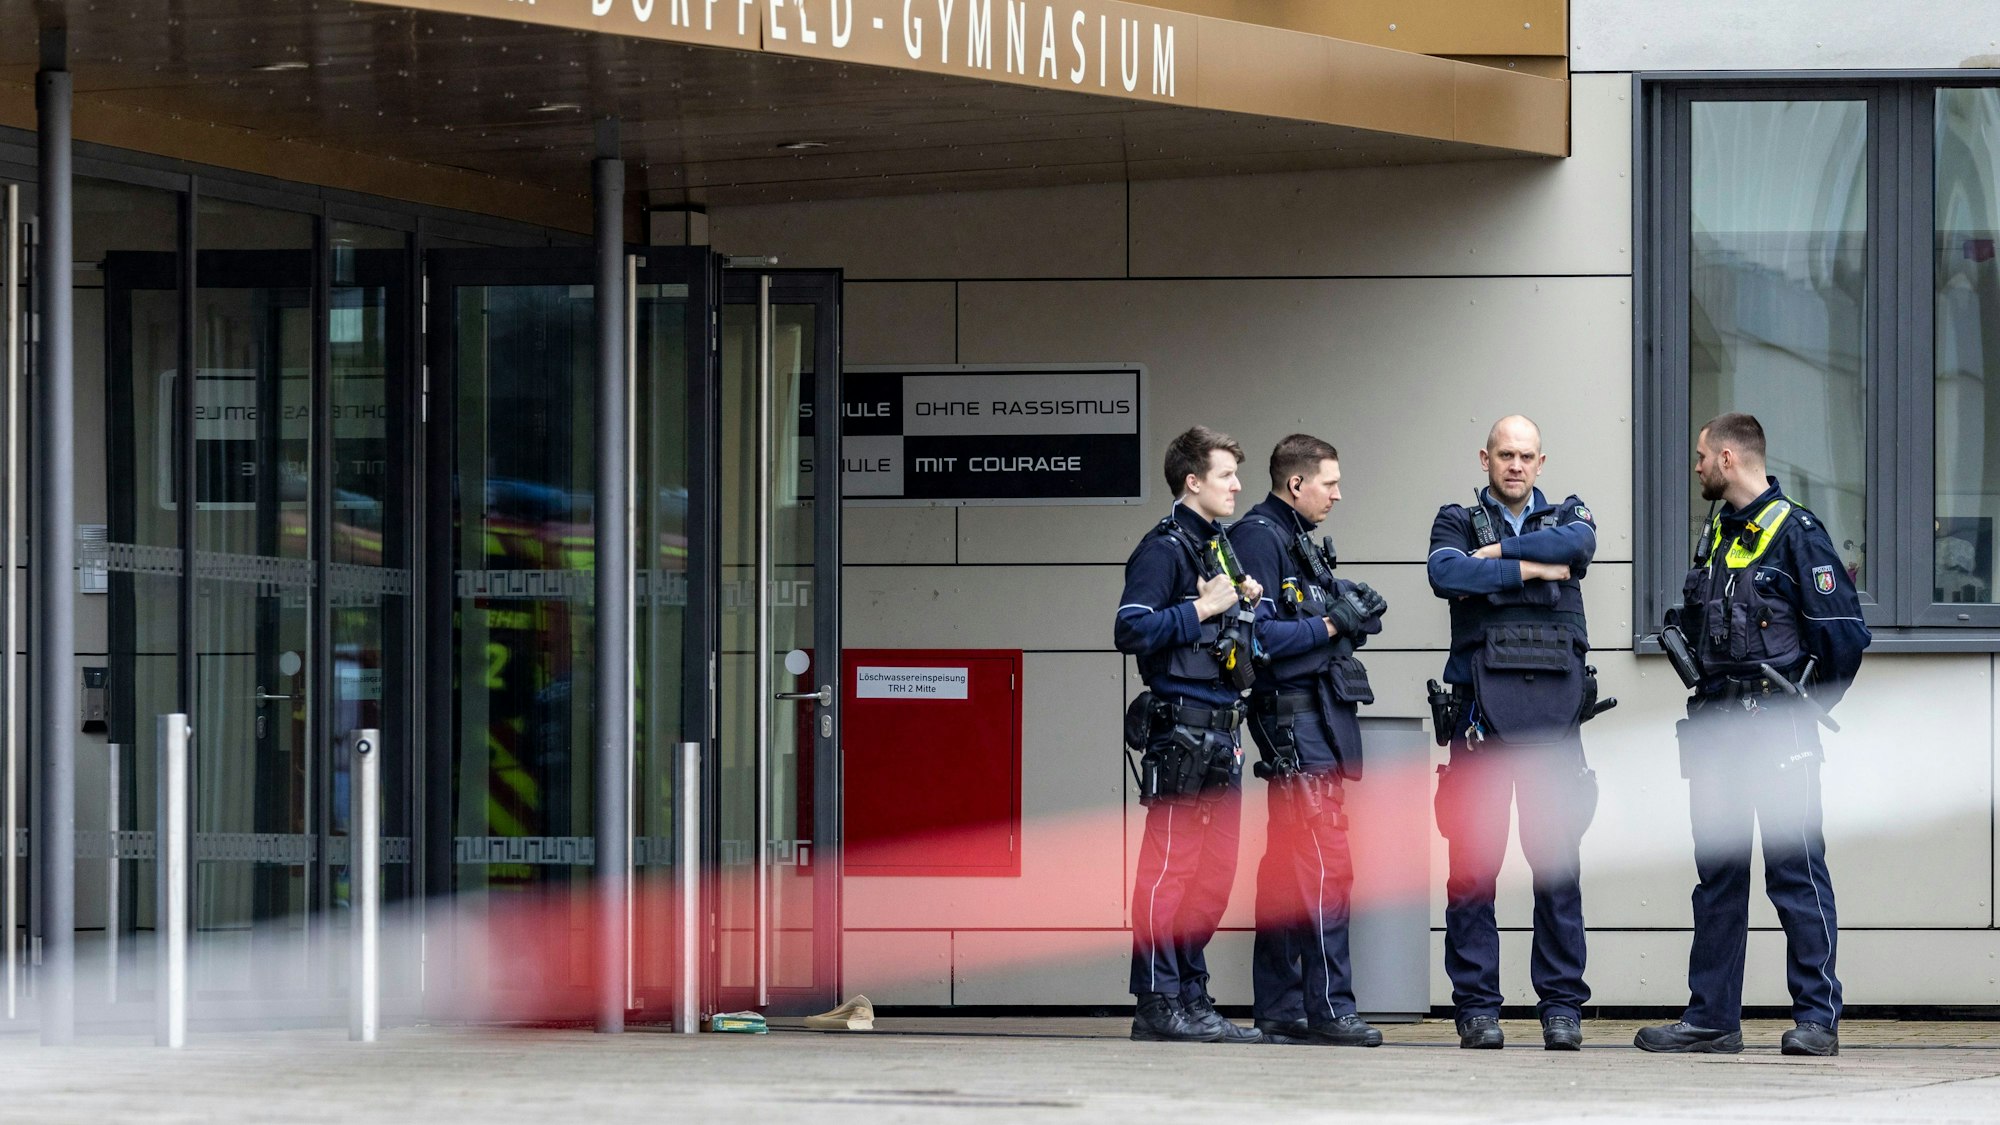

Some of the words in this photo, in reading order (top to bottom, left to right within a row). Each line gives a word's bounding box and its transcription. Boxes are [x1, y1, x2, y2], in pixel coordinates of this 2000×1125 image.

[799, 402, 891, 418] SULE
[915, 401, 980, 417] OHNE
[992, 400, 1131, 416] RASSISMUS
[799, 458, 891, 473] SULE
[915, 457, 958, 473] MIT
[968, 456, 1082, 472] COURAGE
[859, 672, 966, 684] Löschwassereinspeisung
[888, 684, 906, 693] TRH
[908, 684, 913, 693] 2
[915, 684, 937, 693] Mitte
